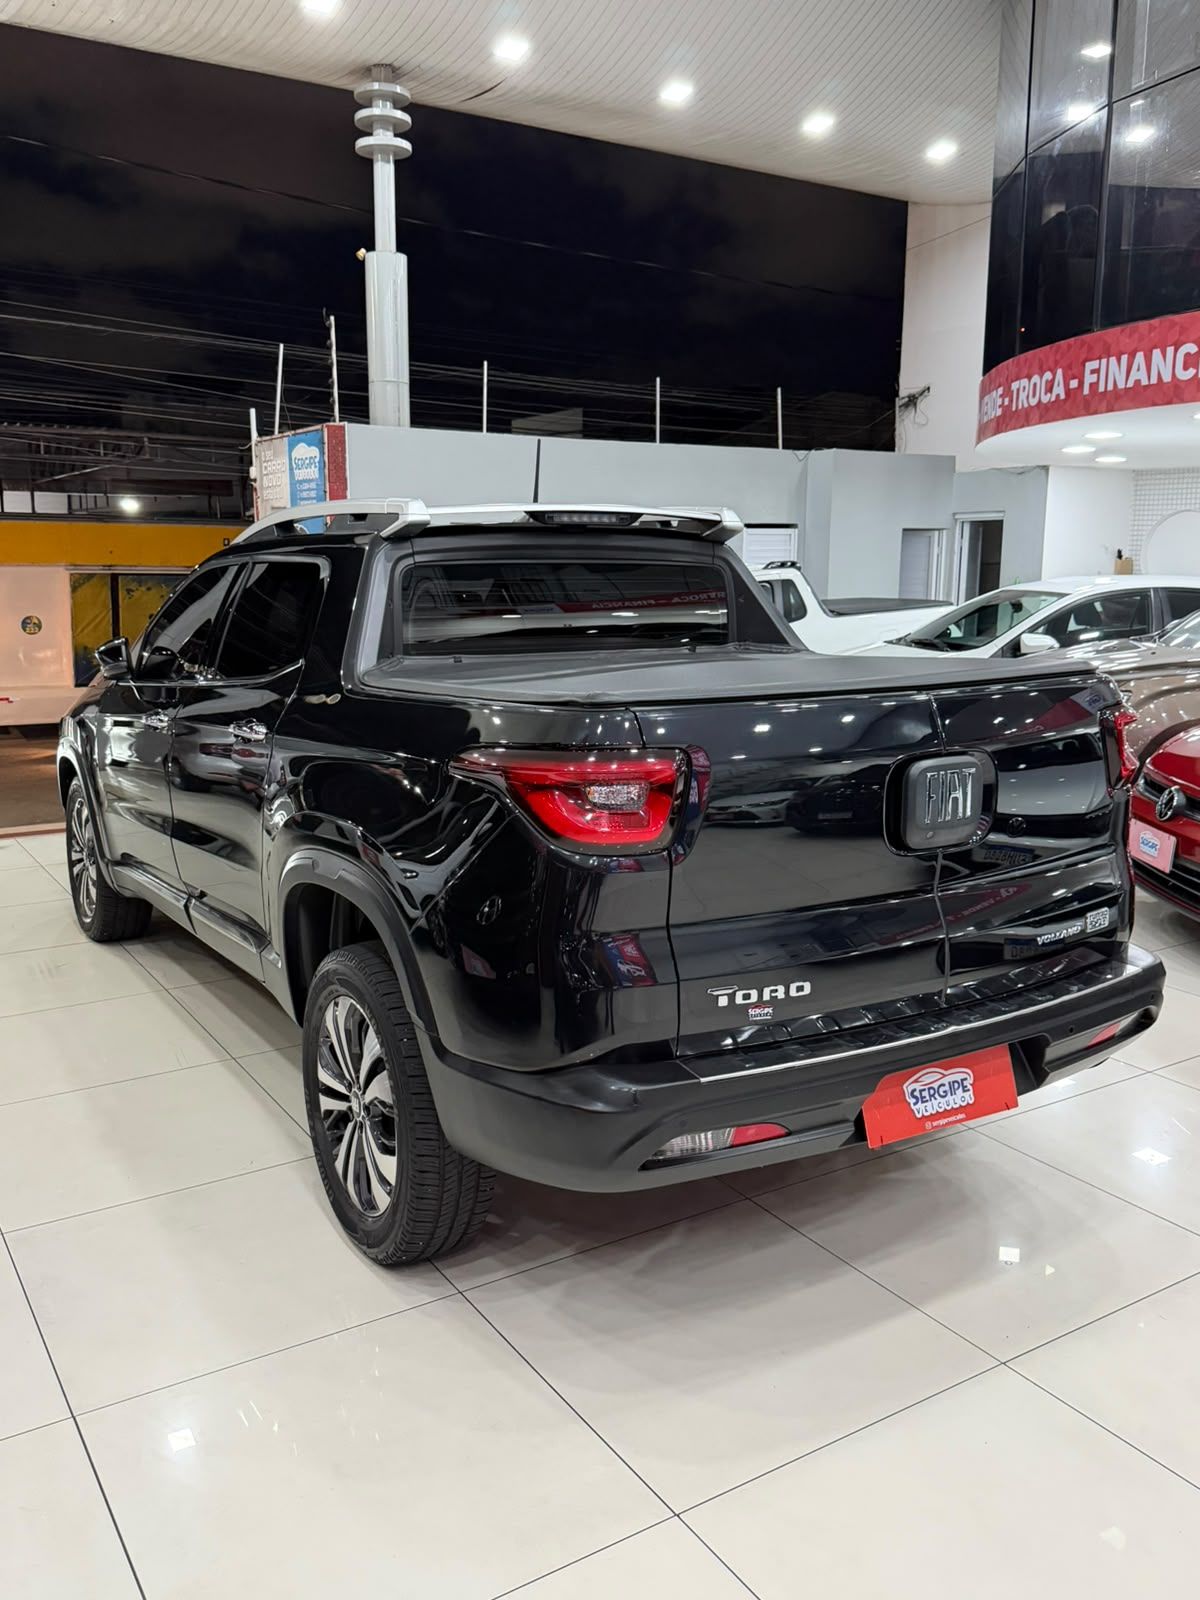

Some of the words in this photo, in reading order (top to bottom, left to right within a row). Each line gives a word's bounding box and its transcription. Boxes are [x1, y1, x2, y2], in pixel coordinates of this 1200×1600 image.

[1011, 368, 1065, 412] TROCA
[1083, 342, 1200, 395] FINANC
[925, 767, 976, 824] FIAT
[707, 981, 811, 1007] TORO
[910, 1077, 970, 1106] SERGIPE
